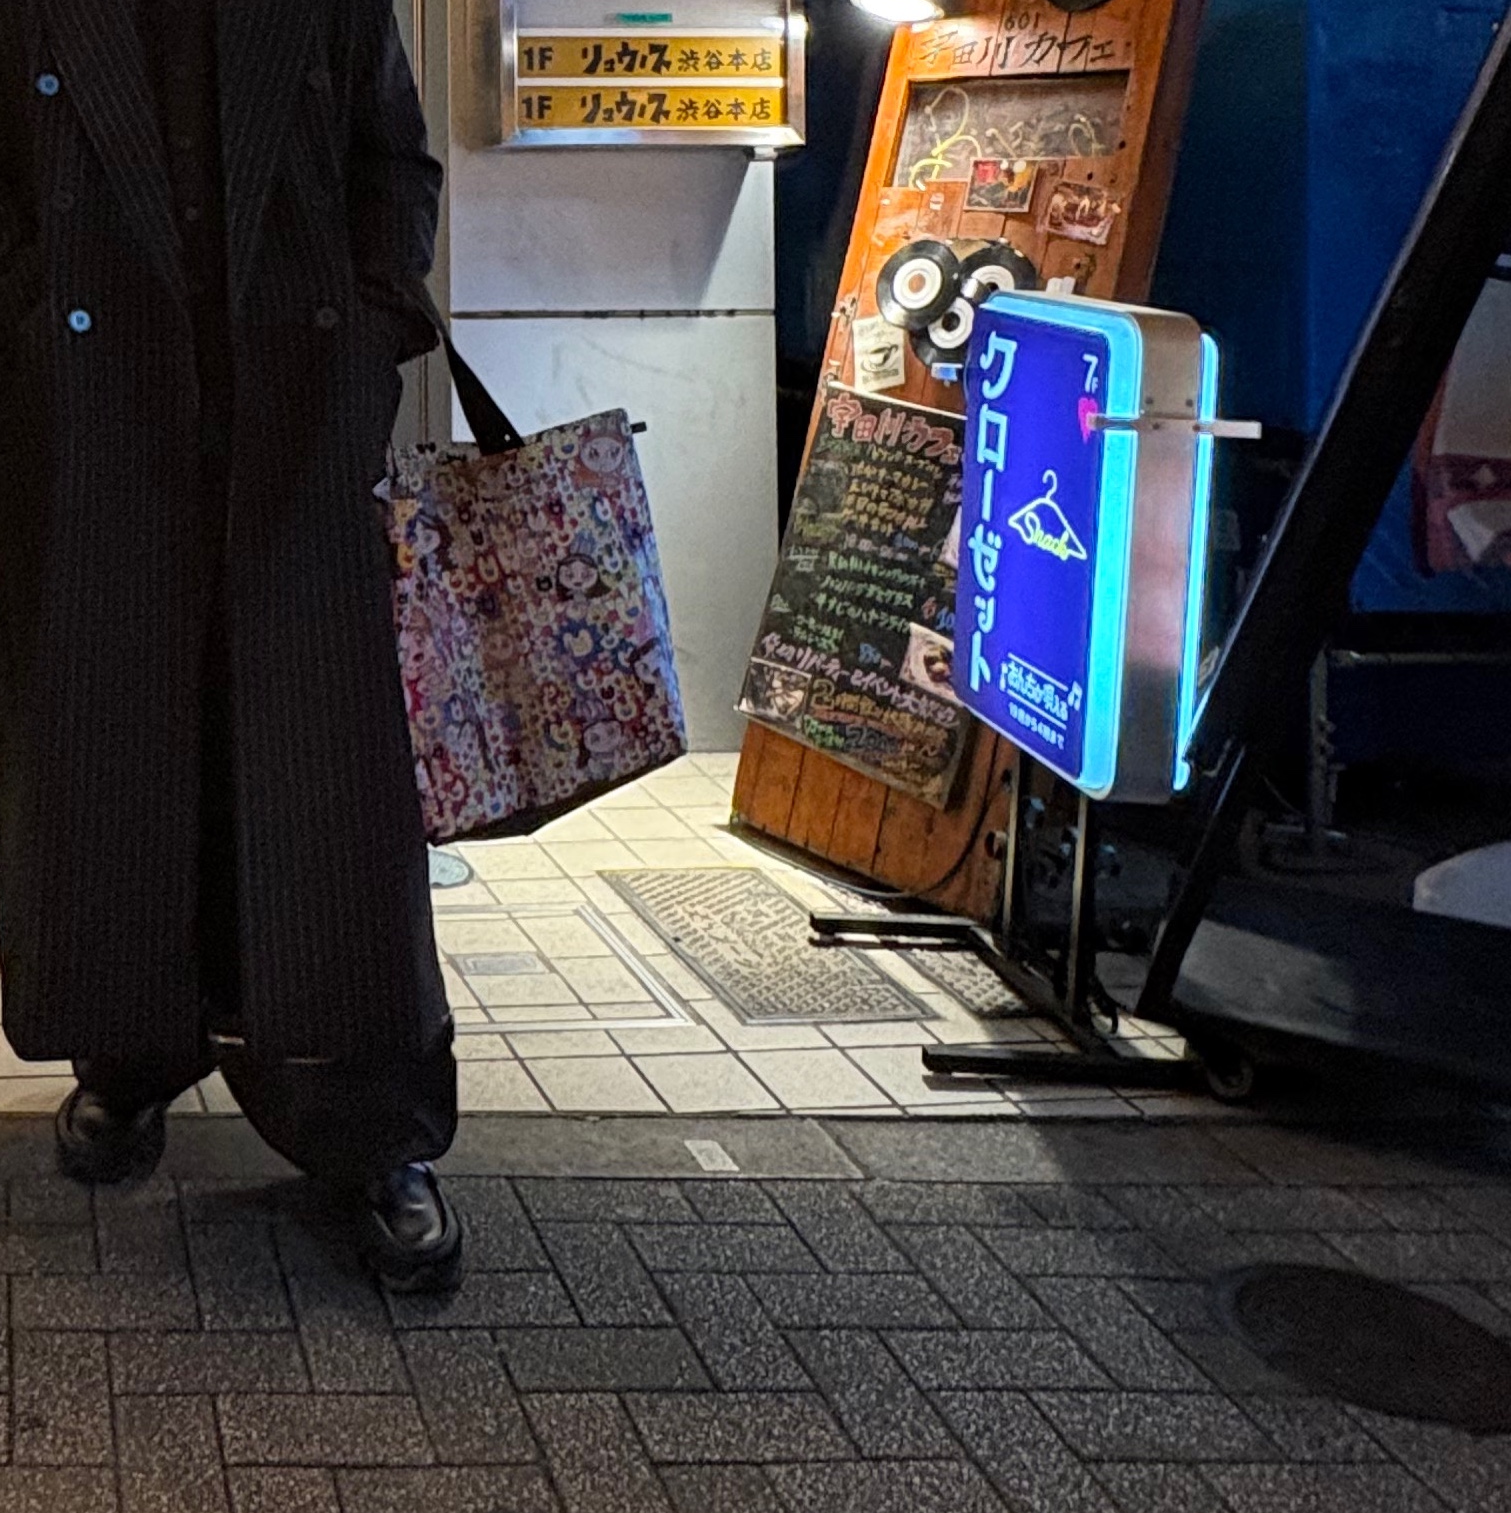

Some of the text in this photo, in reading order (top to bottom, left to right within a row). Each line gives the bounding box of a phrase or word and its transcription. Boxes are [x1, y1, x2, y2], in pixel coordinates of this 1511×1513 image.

[1004, 10, 1041, 34] 601
[523, 46, 554, 72] 1F
[677, 46, 773, 73] 渋谷本店
[521, 95, 553, 120] 1F
[675, 96, 772, 122] 渋谷本店
[826, 390, 963, 466] 宇田川カフェ
[968, 330, 1018, 693] クローゼット
